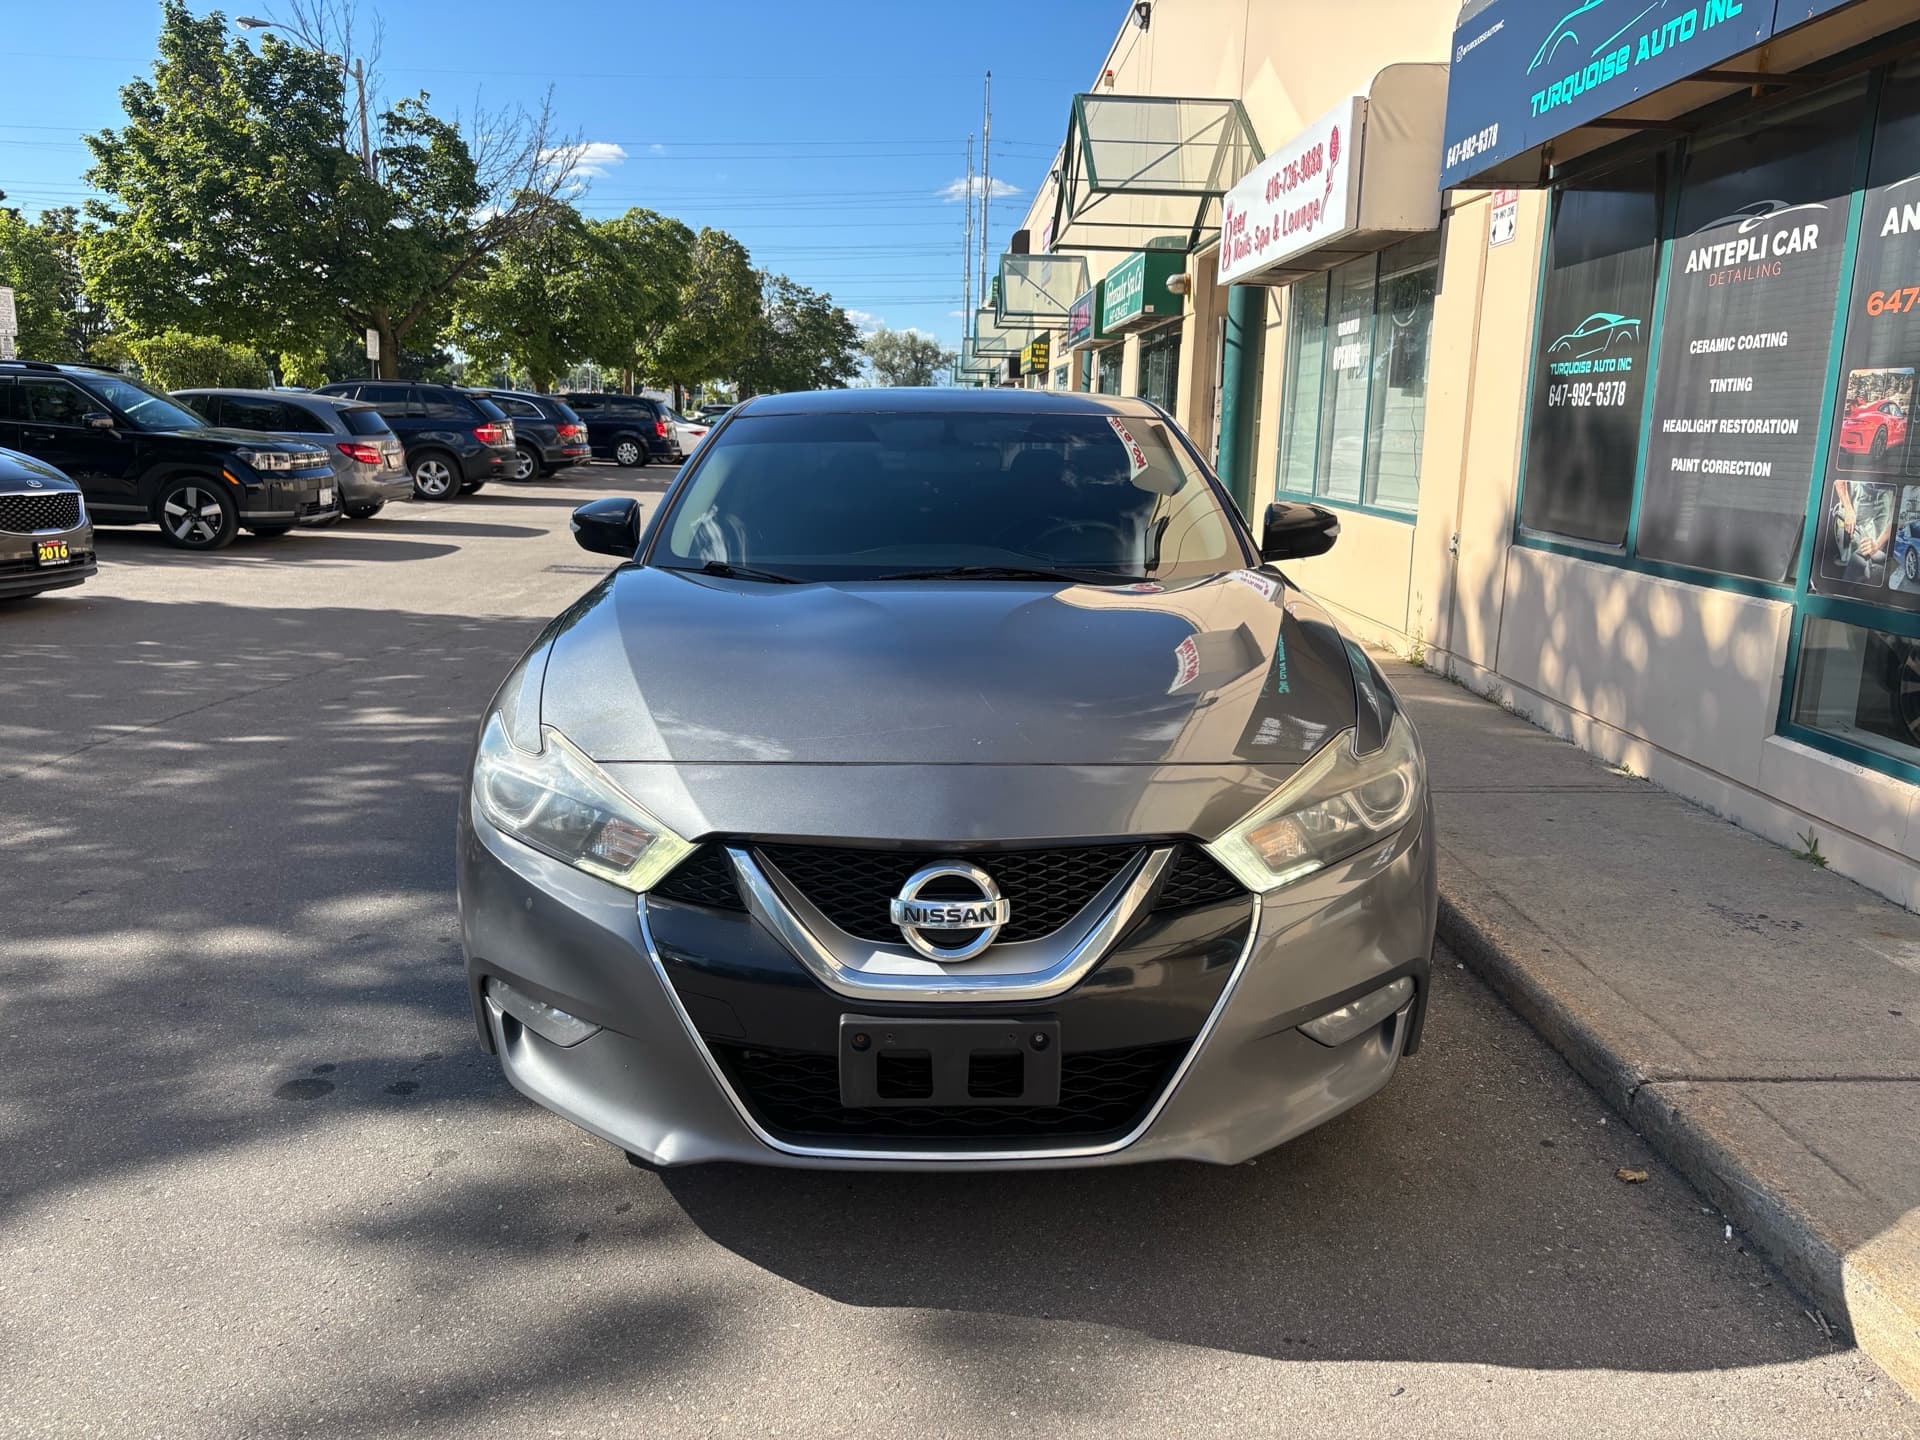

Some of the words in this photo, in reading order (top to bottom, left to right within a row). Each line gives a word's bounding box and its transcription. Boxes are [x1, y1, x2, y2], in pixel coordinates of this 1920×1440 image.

[1634, 8, 1698, 66] AUTO
[1254, 225, 1271, 256] Spa
[1273, 214, 1279, 241] &
[1282, 198, 1320, 237] Lounge
[1684, 233, 1769, 274] ANTEPLI
[1771, 223, 1819, 257] CAR
[1708, 260, 1782, 287] DETAILING
[1689, 336, 1736, 354] CERAMIC
[1737, 331, 1788, 350] COATING
[1593, 358, 1616, 373] AUTO
[1617, 357, 1632, 371] INC
[1548, 380, 1627, 407] 647-992-6378
[1709, 376, 1753, 393] TINTING
[1662, 418, 1719, 433] HEADLIGHT
[1719, 418, 1799, 434] RESTORATION
[1670, 457, 1700, 472] PAINT
[1701, 459, 1772, 477] CORRECTION
[39, 544, 68, 561] 2016
[903, 906, 998, 924] NISSAN
